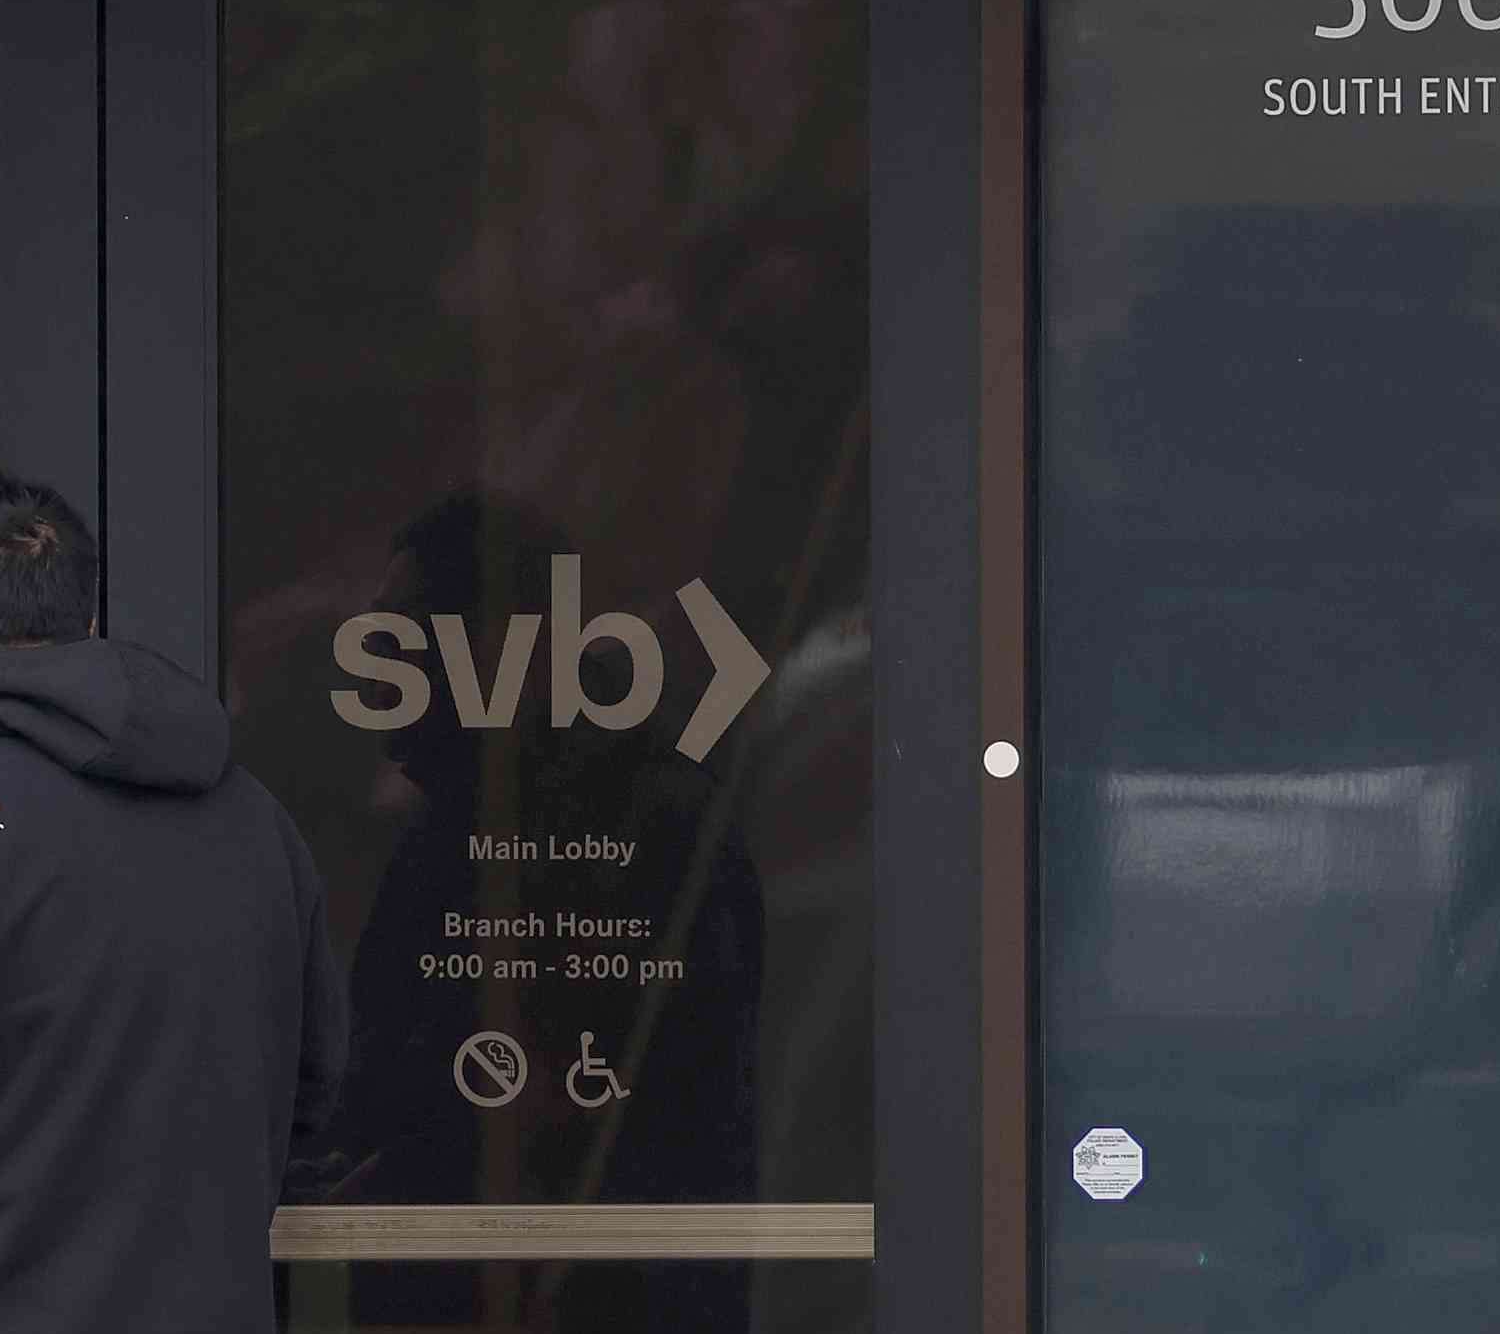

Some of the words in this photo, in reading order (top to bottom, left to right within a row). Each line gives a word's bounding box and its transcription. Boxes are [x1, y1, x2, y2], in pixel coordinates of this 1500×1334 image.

[1263, 78, 1401, 116] SOUTH
[331, 554, 664, 731] svb
[469, 835, 537, 860] Main
[549, 834, 636, 866] Lobby
[445, 912, 545, 937] Branch
[556, 912, 651, 937] Hours:
[419, 954, 483, 979] 9:00
[493, 960, 537, 979] am
[565, 954, 629, 979] 3:00
[639, 960, 683, 986] pm
